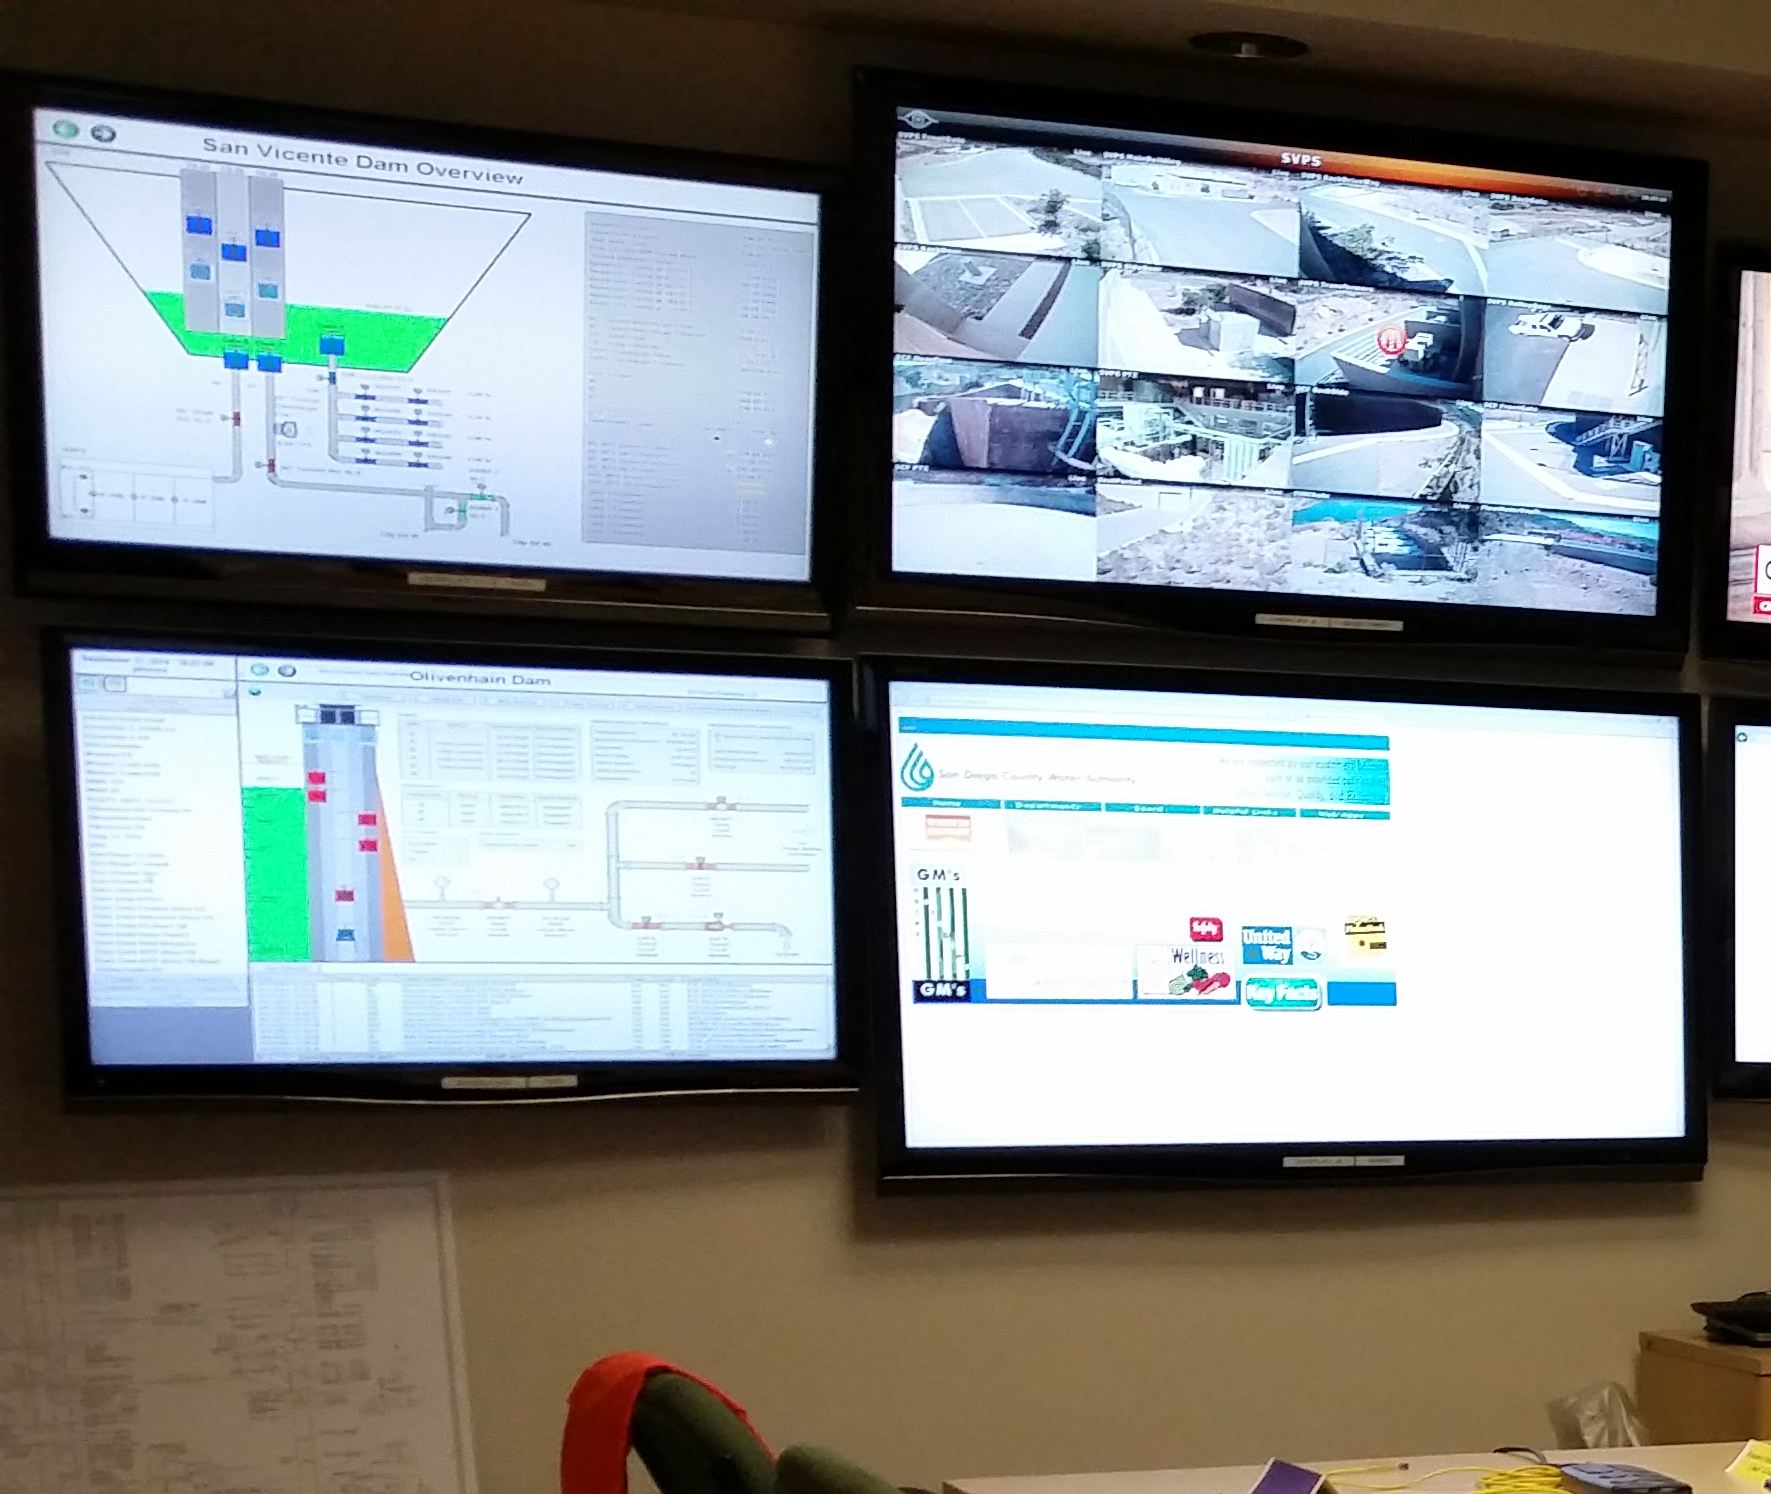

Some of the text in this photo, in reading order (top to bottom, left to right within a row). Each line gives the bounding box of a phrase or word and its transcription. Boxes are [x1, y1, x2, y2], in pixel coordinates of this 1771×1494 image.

[203, 138, 525, 186] San Vicente Dam Overview
[1281, 152, 1323, 168] SVPS
[409, 671, 551, 687] Olivenhain Dam
[916, 868, 961, 882] GM's
[1242, 928, 1292, 946] United
[1171, 947, 1226, 965] Wellness
[1261, 945, 1292, 965] Way
[919, 981, 968, 999] GM's
